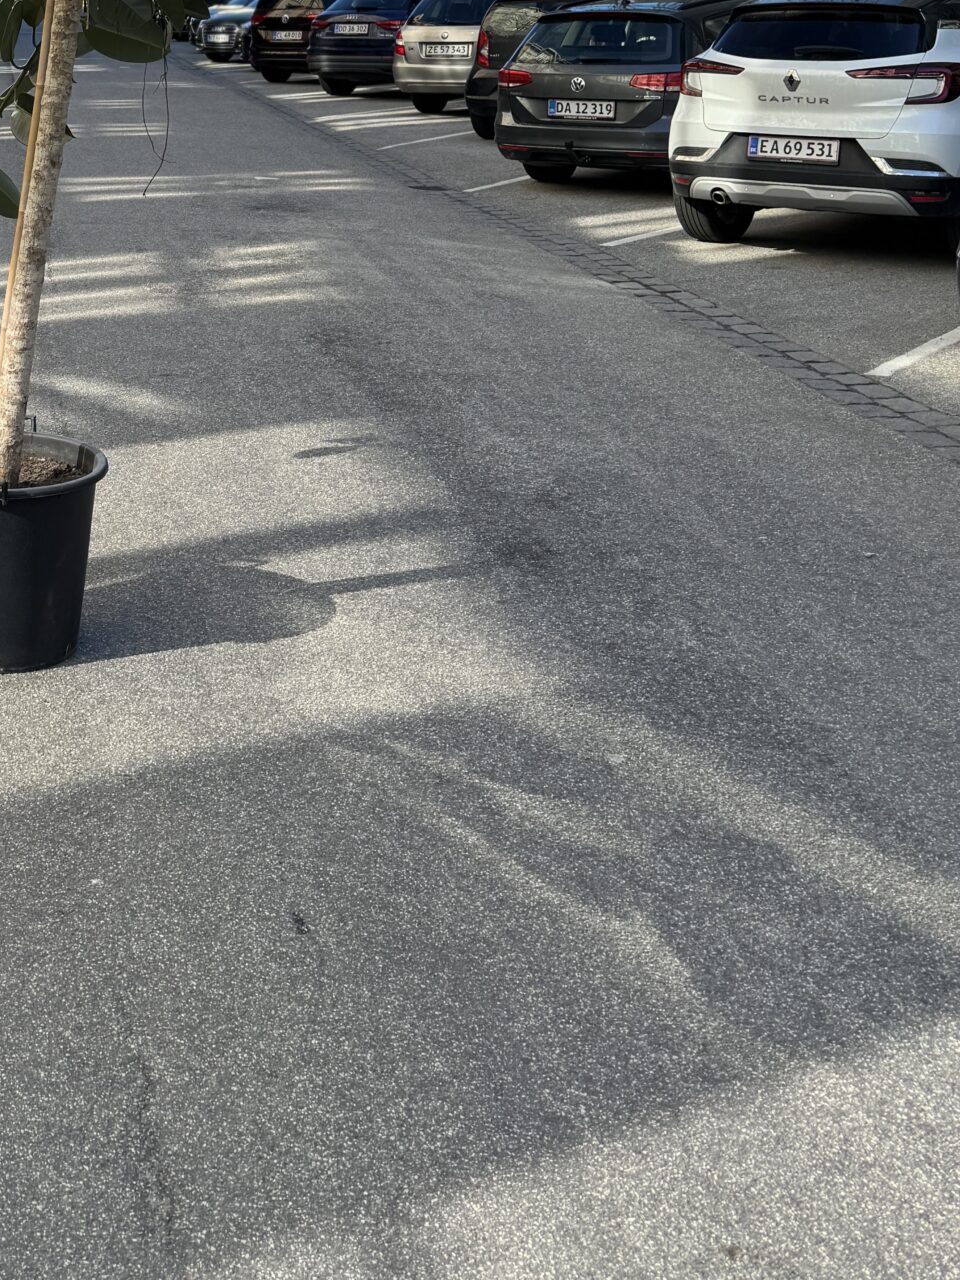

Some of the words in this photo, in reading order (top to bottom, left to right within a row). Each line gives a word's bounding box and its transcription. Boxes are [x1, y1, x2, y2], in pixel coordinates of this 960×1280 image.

[427, 46, 438, 54] ZE
[440, 46, 449, 54] 57
[451, 46, 466, 54] 343
[757, 95, 830, 105] CAPTUR
[556, 102, 571, 113] DA
[575, 102, 588, 114] 12
[590, 103, 612, 115] 319
[759, 139, 780, 155] EA
[783, 140, 803, 156] 69
[805, 141, 833, 158] 531
